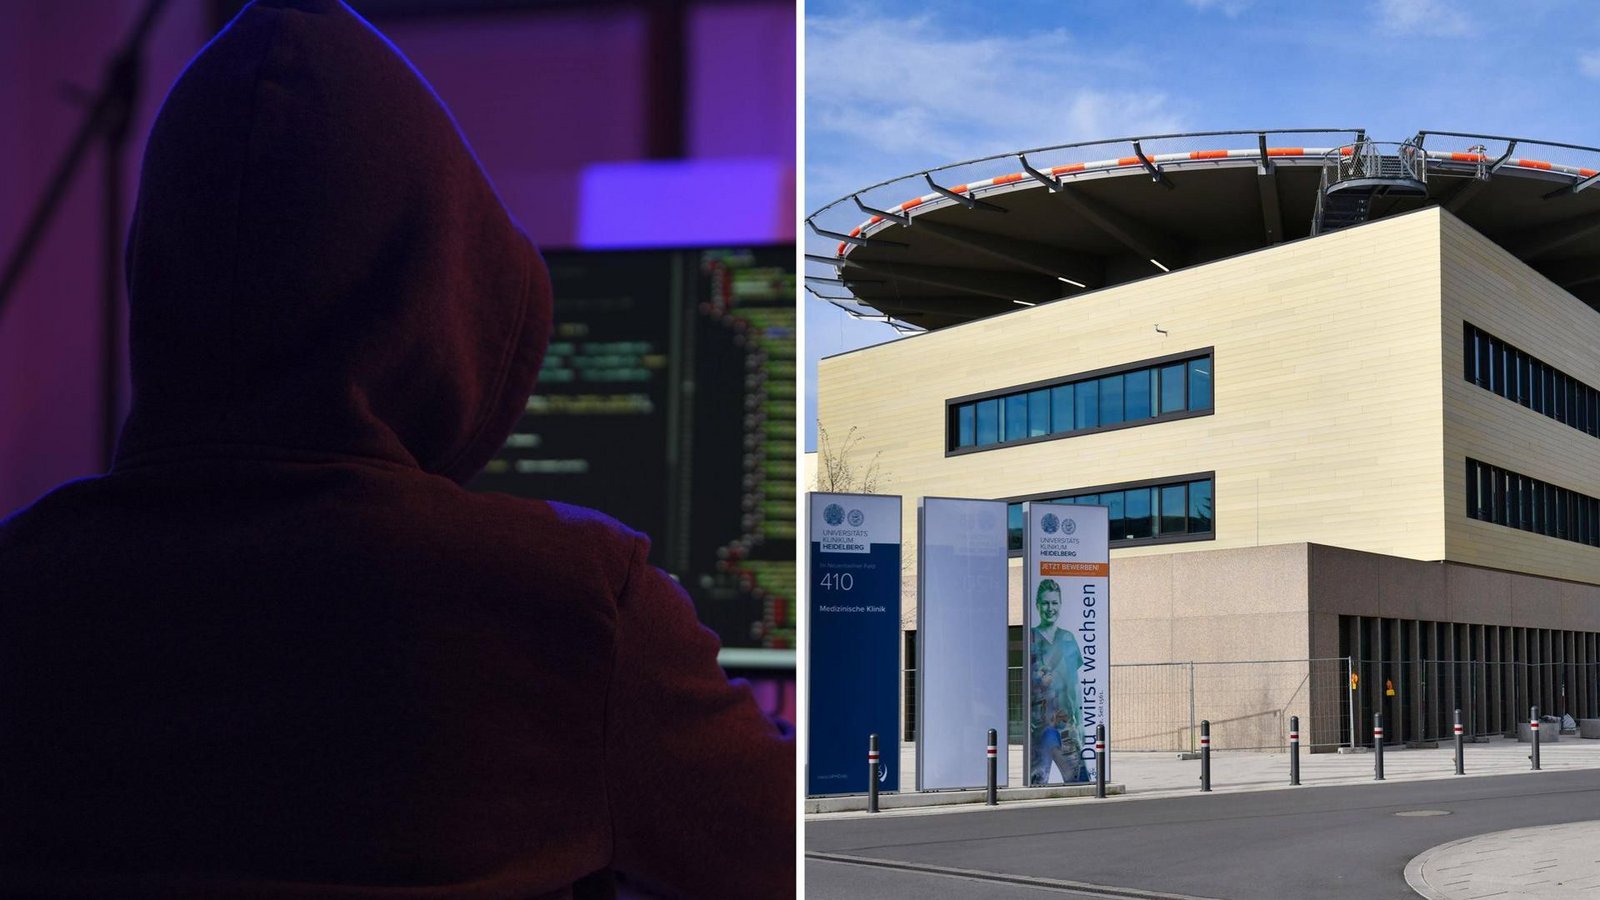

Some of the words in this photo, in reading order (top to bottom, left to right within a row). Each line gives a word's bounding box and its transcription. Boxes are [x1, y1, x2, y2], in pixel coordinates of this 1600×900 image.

[822, 529, 868, 537] UNIVERSITÄTS
[1062, 563, 1100, 571] BEWERBEN!
[820, 572, 854, 591] 410
[819, 605, 865, 613] Medizinische
[866, 605, 886, 613] Klinik
[1079, 584, 1096, 672] wachsen
[1079, 678, 1096, 728] wirst
[1080, 734, 1097, 760] Du
